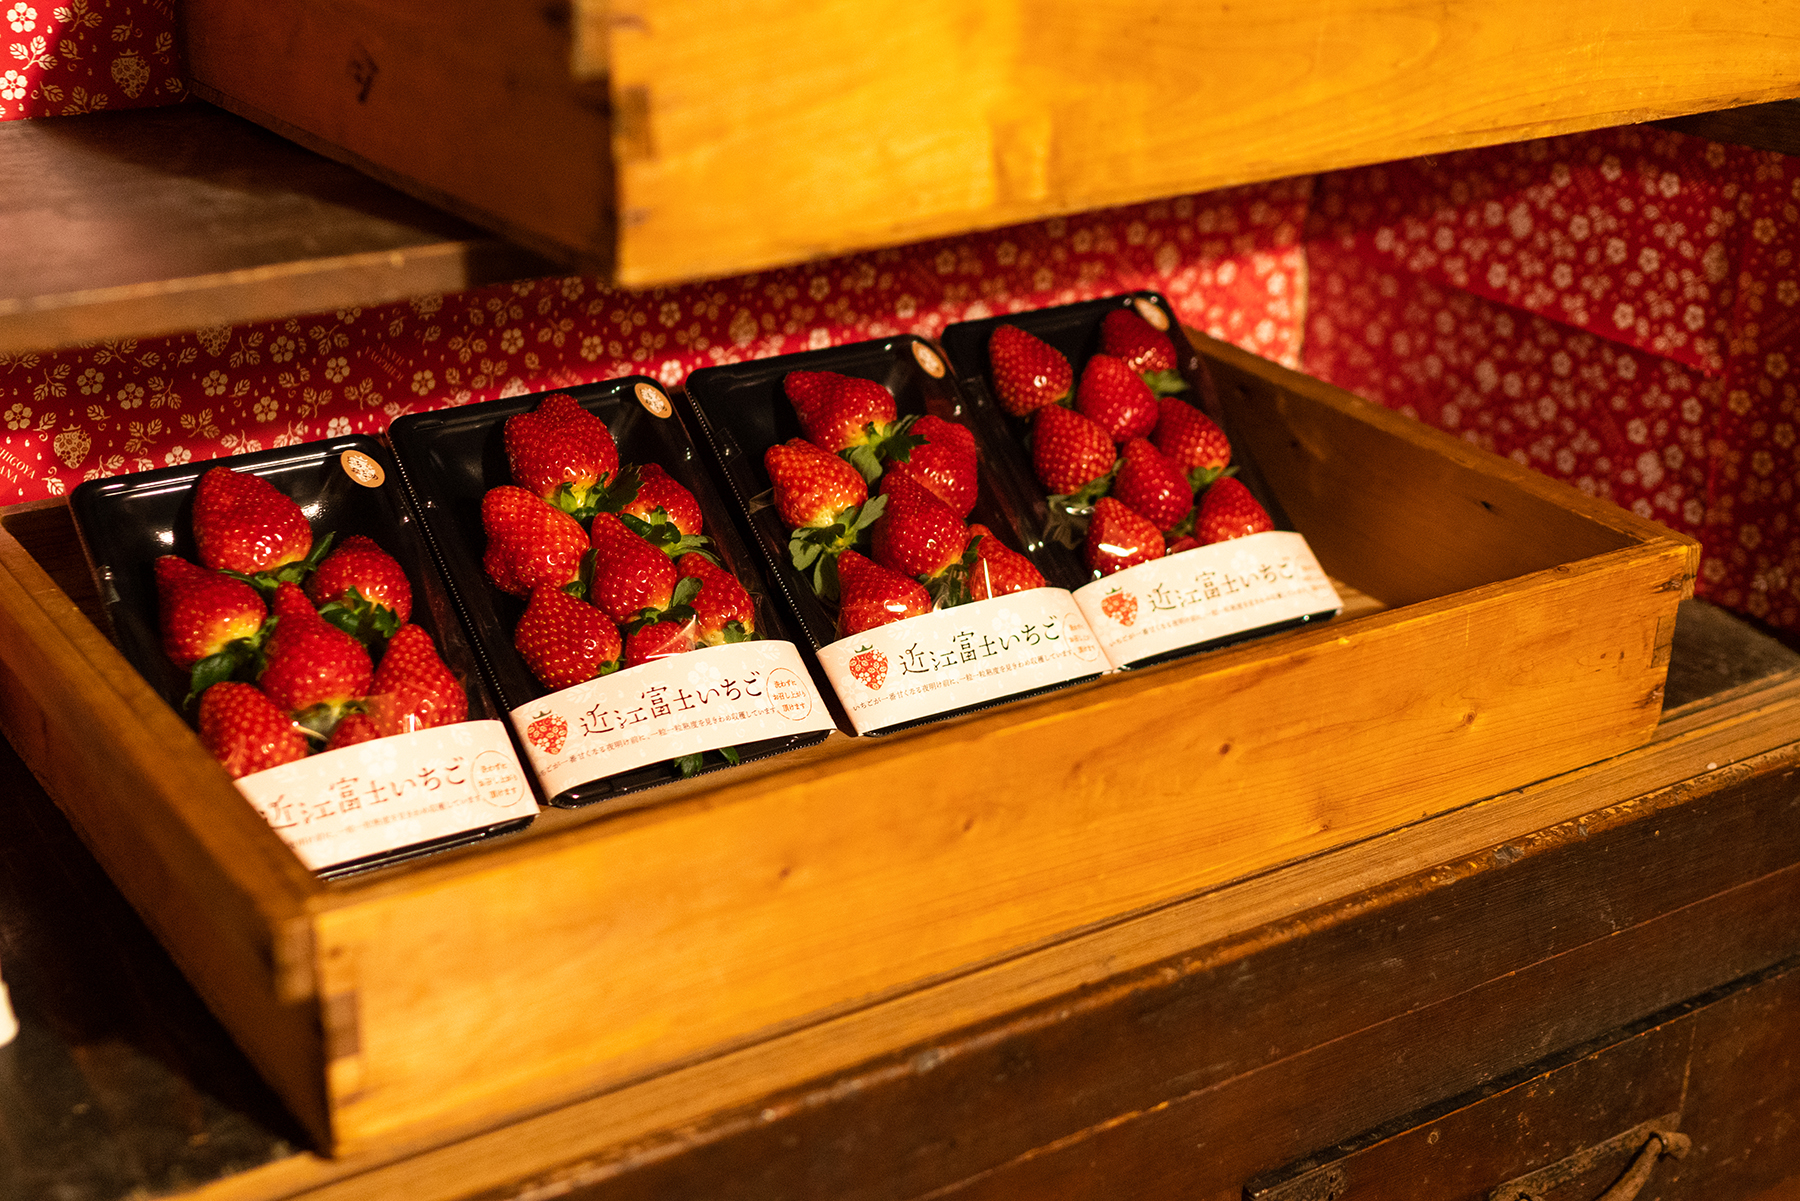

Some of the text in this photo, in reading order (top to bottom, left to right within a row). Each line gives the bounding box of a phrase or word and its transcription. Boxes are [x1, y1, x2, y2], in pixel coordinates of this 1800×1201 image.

[0, 447, 36, 480] HIGOYA
[1148, 556, 1294, 612] 近江富士いちご
[899, 615, 1060, 676] 近江富士いちご
[579, 671, 763, 737] 近江富士いちご
[262, 756, 466, 829] 近江富士いちご
